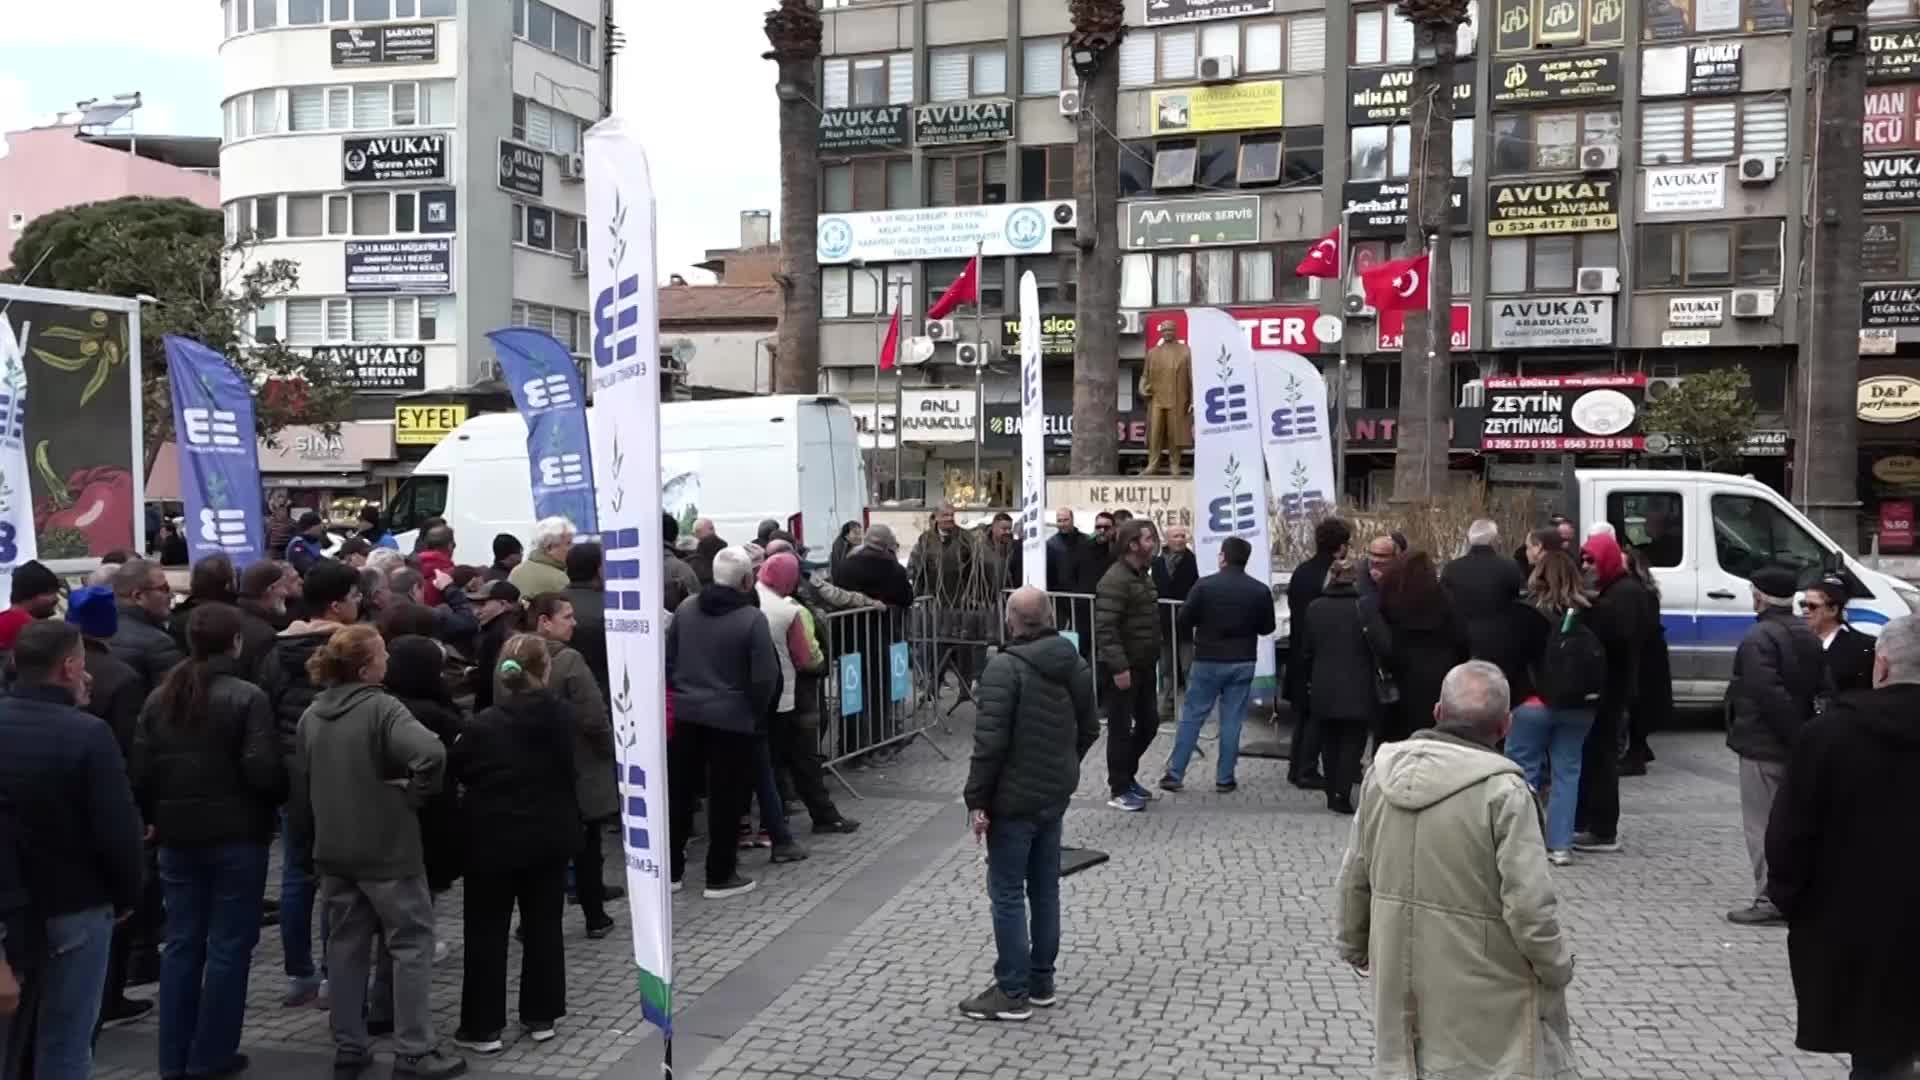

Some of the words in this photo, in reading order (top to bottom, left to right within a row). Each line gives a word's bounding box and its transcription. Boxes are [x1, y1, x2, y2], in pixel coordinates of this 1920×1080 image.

[1693, 46, 1741, 64] AVUKAT
[1353, 87, 1408, 107] NİHAN
[1863, 93, 1905, 115] MAN
[819, 107, 902, 128] AVUKAT
[917, 103, 1011, 125] AVUKAT
[1862, 113, 1902, 145] RCÜ
[367, 135, 443, 155] AVUKAT
[406, 157, 438, 168] AKIN
[1652, 171, 1719, 189] AVUKAT
[1496, 182, 1612, 203] AVUKAT
[1175, 210, 1212, 223] TEKNİK
[1214, 206, 1252, 221] SERVİS
[1498, 204, 1546, 218] YENAL
[1551, 201, 1609, 217] TAVŞAN
[1494, 222, 1505, 233] 0
[1508, 219, 1534, 231] 534
[1594, 216, 1612, 227] 16
[1500, 300, 1605, 318] AVUKAT
[1672, 301, 1720, 315] AVUKAT
[1515, 317, 1590, 327] ARABULUCU
[1239, 317, 1308, 347] TER
[1871, 384, 1908, 399] D&P
[920, 399, 959, 413] ANLI
[1491, 390, 1563, 413] ZEYTİN
[399, 408, 460, 429] EYFEL
[902, 417, 976, 431] KUYUMCULU
[1484, 416, 1563, 435] ZEYTİNYAĞI
[1486, 439, 1493, 449] 0
[1514, 439, 1530, 449] 373
[1532, 439, 1538, 449] 0
[1541, 439, 1557, 449] 155
[1589, 439, 1605, 449] 373
[1089, 487, 1110, 503] NE
[1115, 487, 1171, 504] MUTLU
